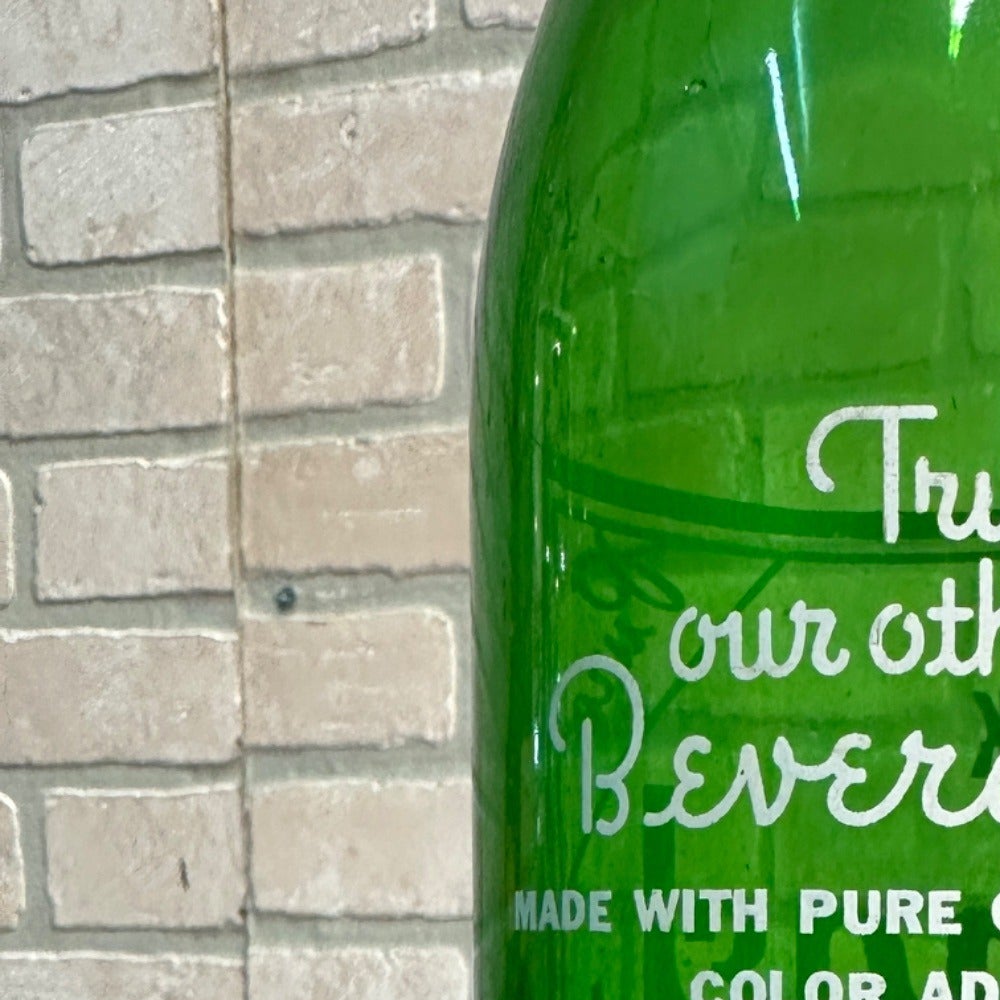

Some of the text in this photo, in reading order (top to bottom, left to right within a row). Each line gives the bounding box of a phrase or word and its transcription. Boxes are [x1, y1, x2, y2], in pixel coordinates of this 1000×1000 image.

[670, 601, 850, 681] our
[514, 889, 612, 933] MADE
[635, 889, 767, 932] WITH
[800, 889, 962, 935] PURE
